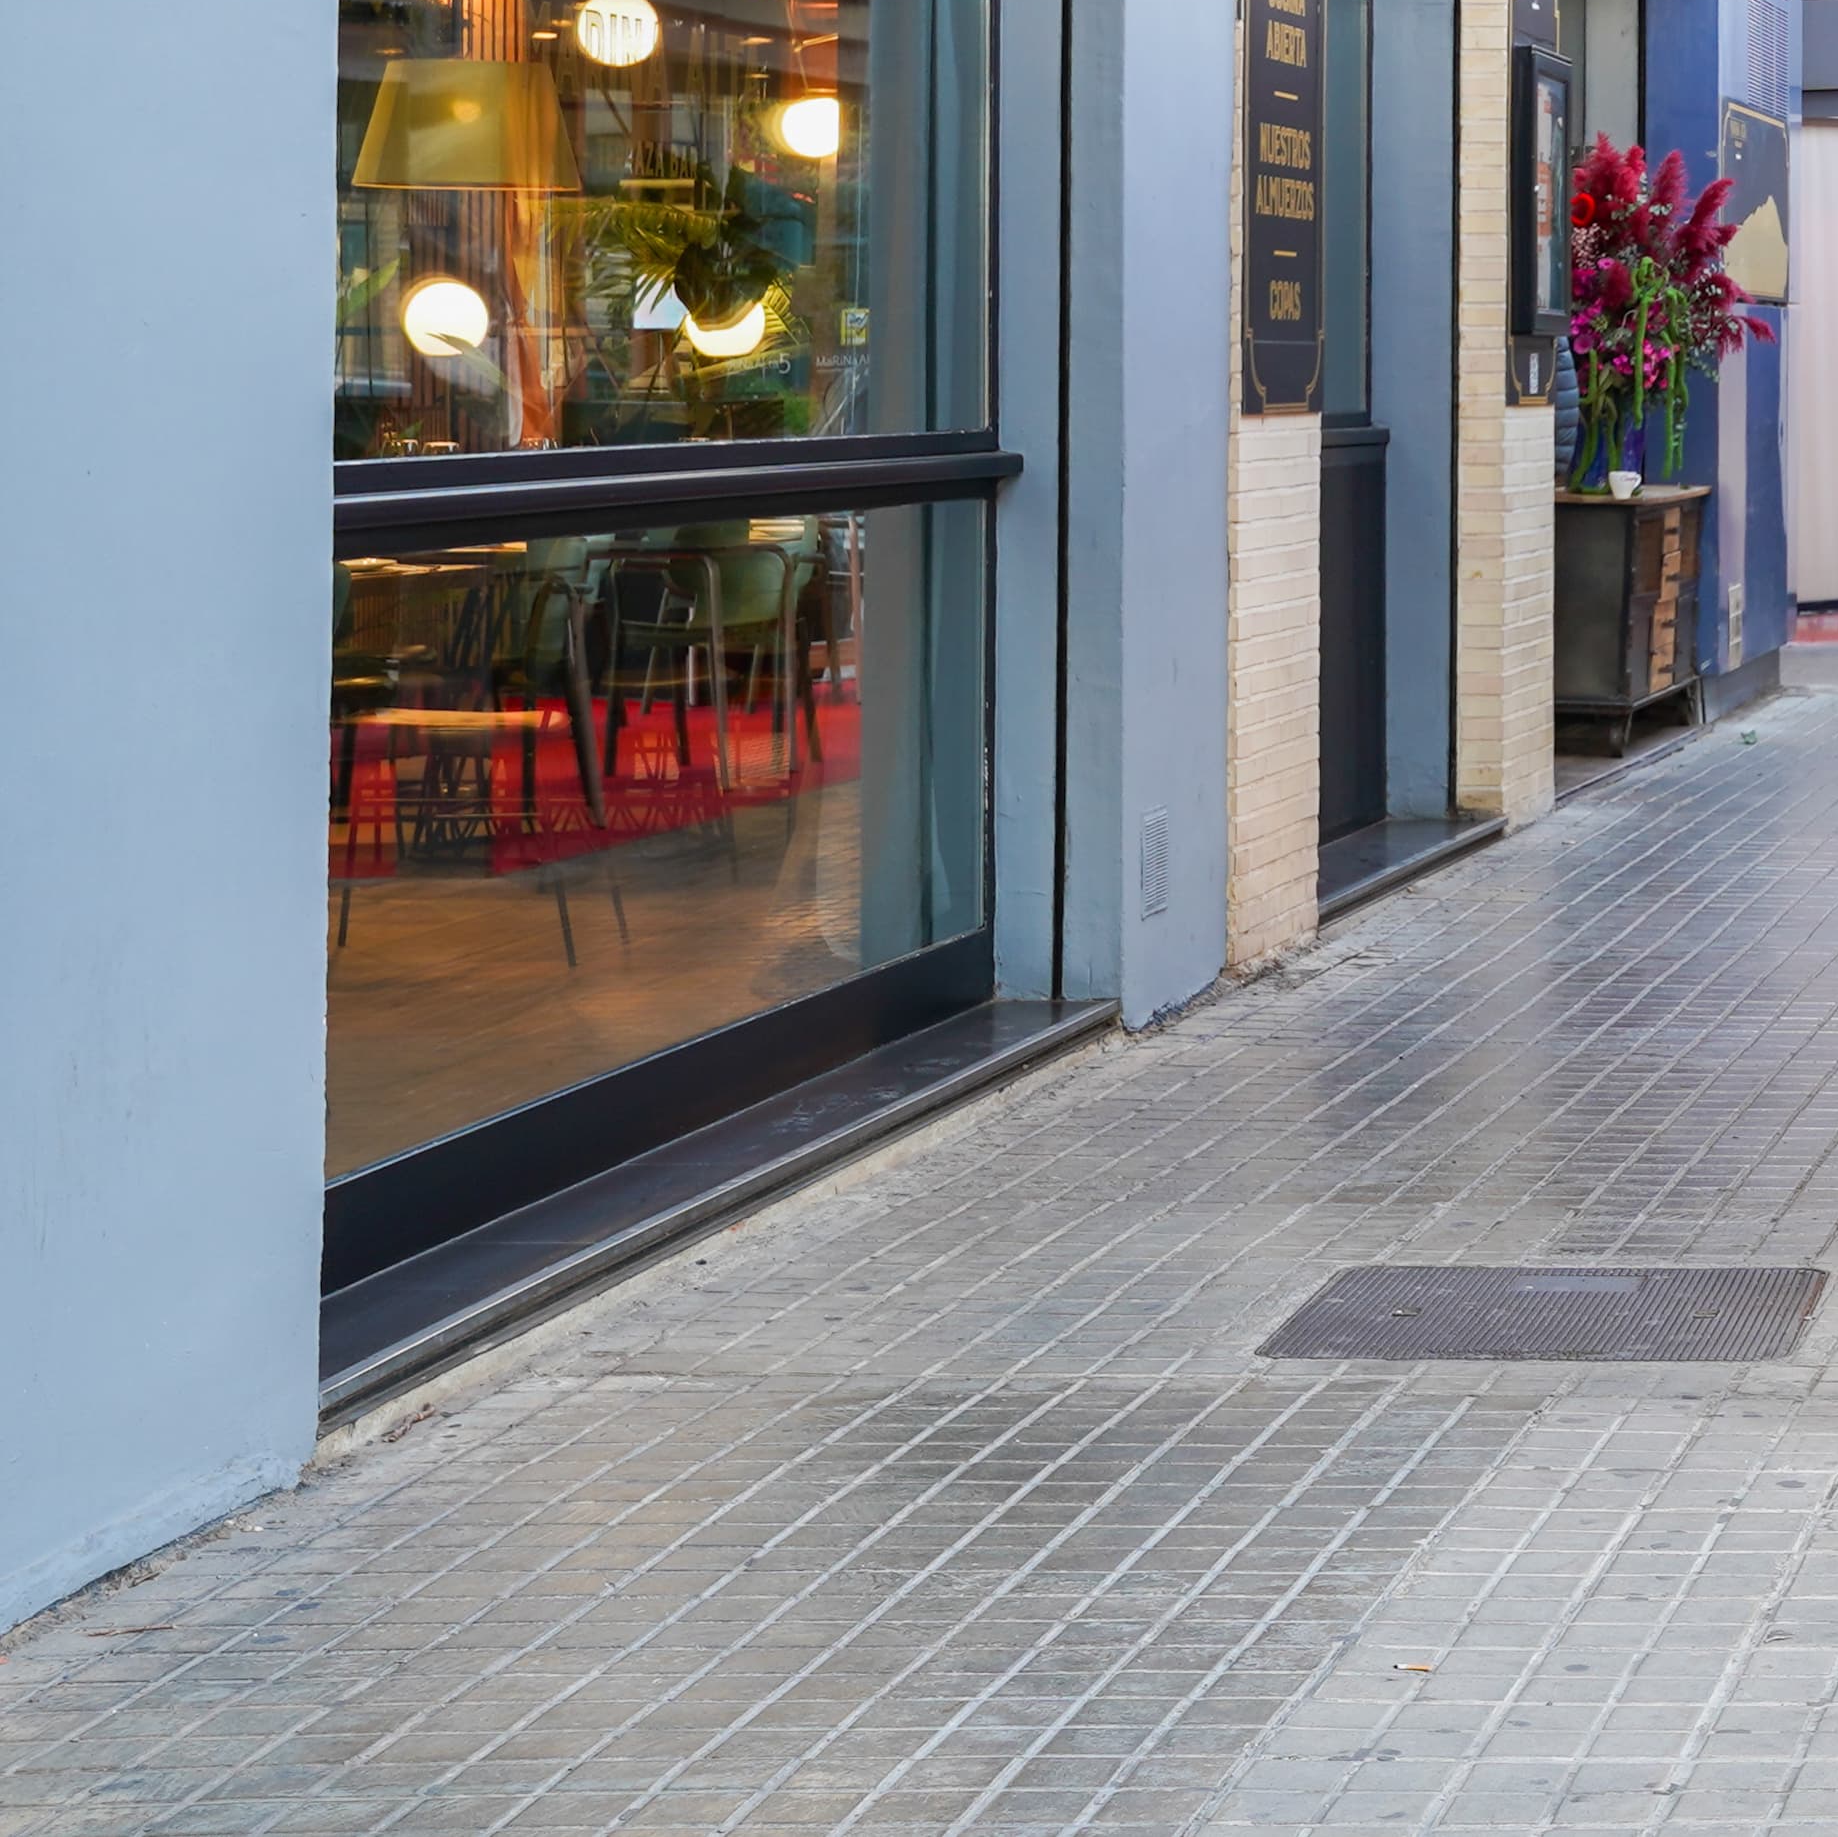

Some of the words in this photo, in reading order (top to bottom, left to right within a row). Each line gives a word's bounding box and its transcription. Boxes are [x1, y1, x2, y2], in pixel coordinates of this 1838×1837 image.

[1265, 19, 1308, 68] ABIERTA
[1259, 121, 1312, 170] NUESTROS
[1255, 174, 1315, 222] ALMUERZOS
[1269, 279, 1301, 322] COPAS
